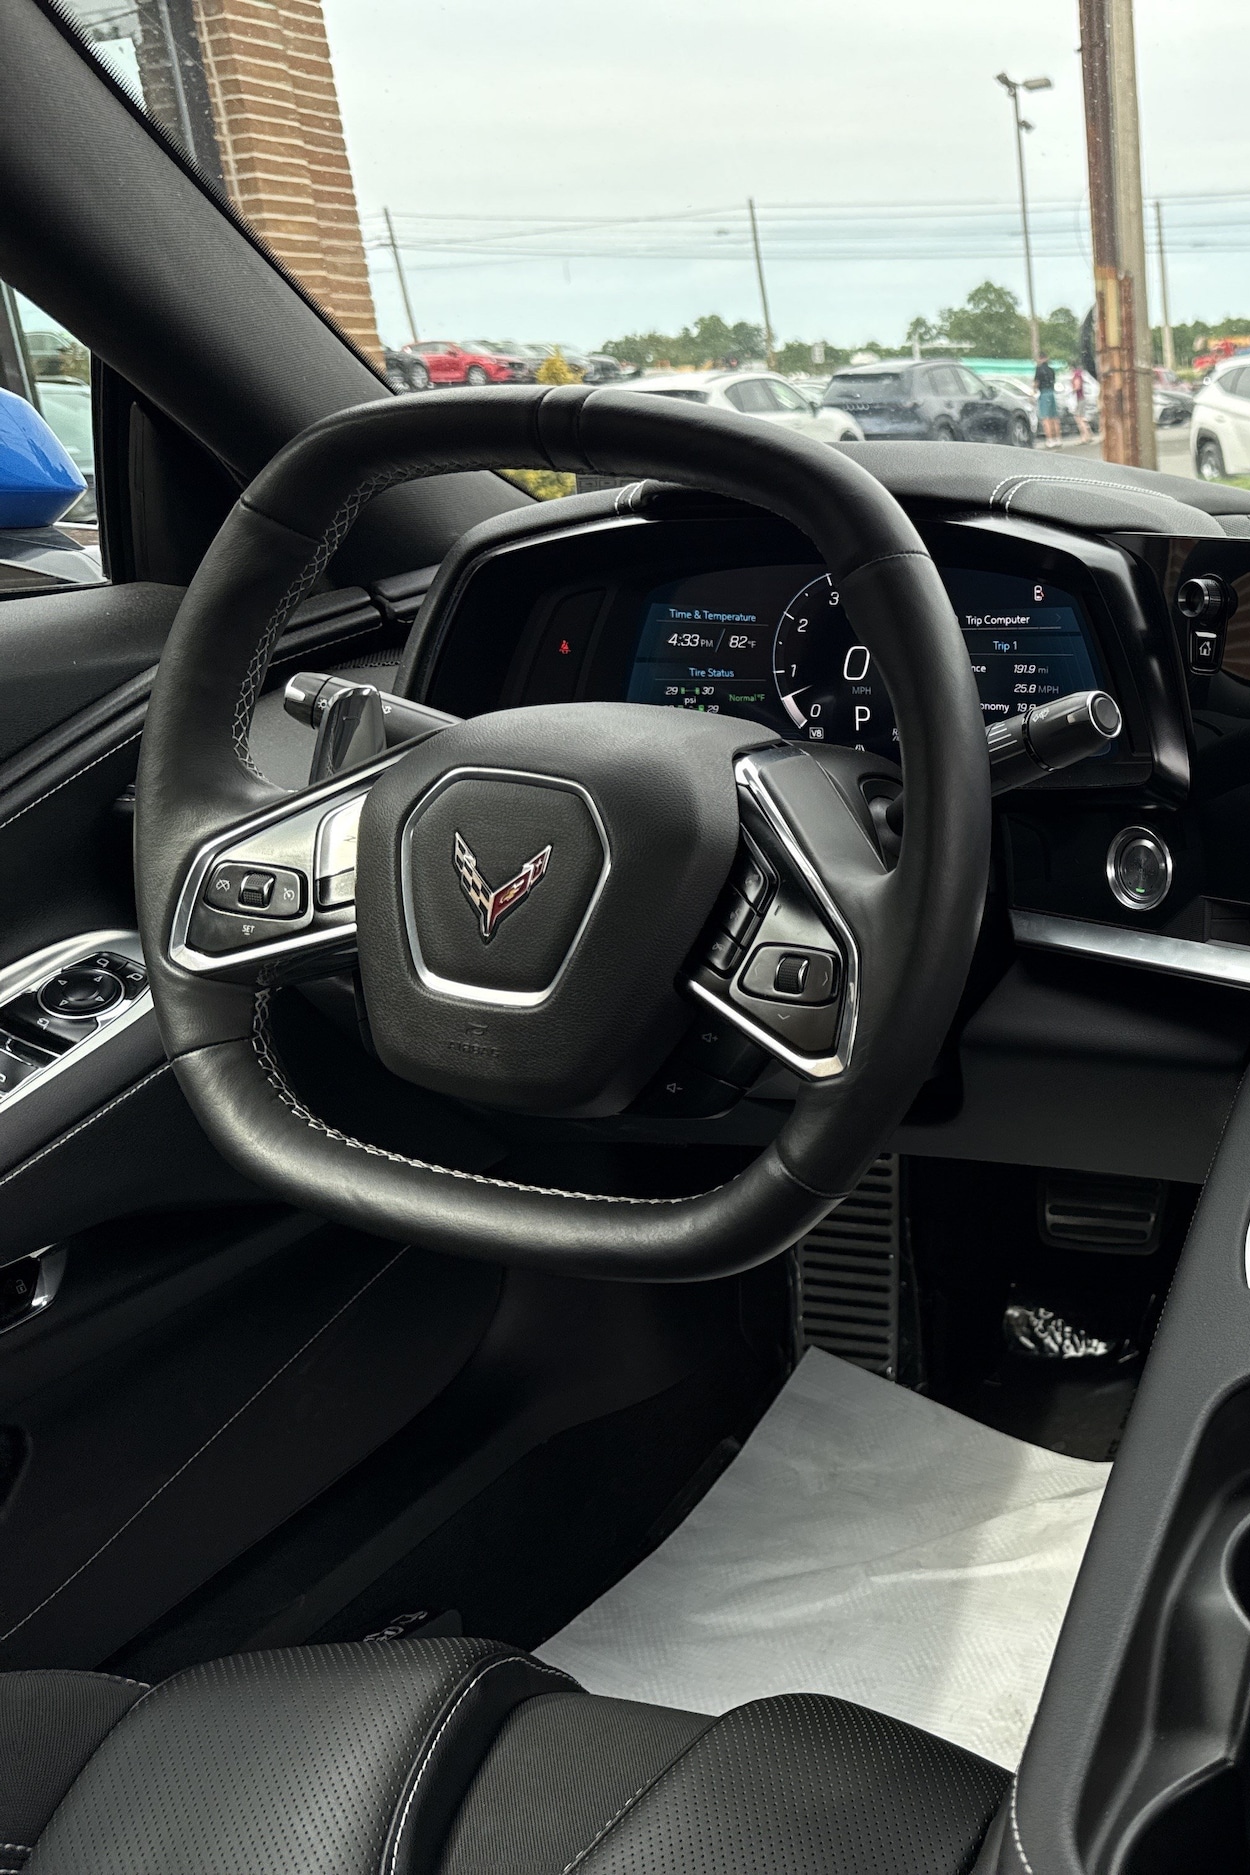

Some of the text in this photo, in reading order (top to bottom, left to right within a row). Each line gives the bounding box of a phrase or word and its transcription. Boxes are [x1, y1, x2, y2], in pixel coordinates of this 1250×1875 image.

[829, 591, 839, 606] 3
[670, 609, 756, 622] Time & Temperature
[966, 615, 1030, 626] Trip Computer
[798, 619, 808, 632] 2
[668, 634, 700, 647] 4:33
[993, 641, 1017, 652] Trip 1
[844, 646, 870, 680] 0
[689, 668, 734, 678] Tire Status
[791, 664, 796, 678] 1
[665, 687, 678, 695] 29
[702, 687, 714, 695] 30
[852, 686, 872, 695] MPH
[1014, 684, 1036, 694] 25.8
[684, 697, 696, 705] psi
[729, 694, 756, 702] Normal
[810, 704, 822, 718] 0
[855, 706, 870, 731] P
[811, 730, 822, 738] V8
[242, 924, 255, 933] SET
